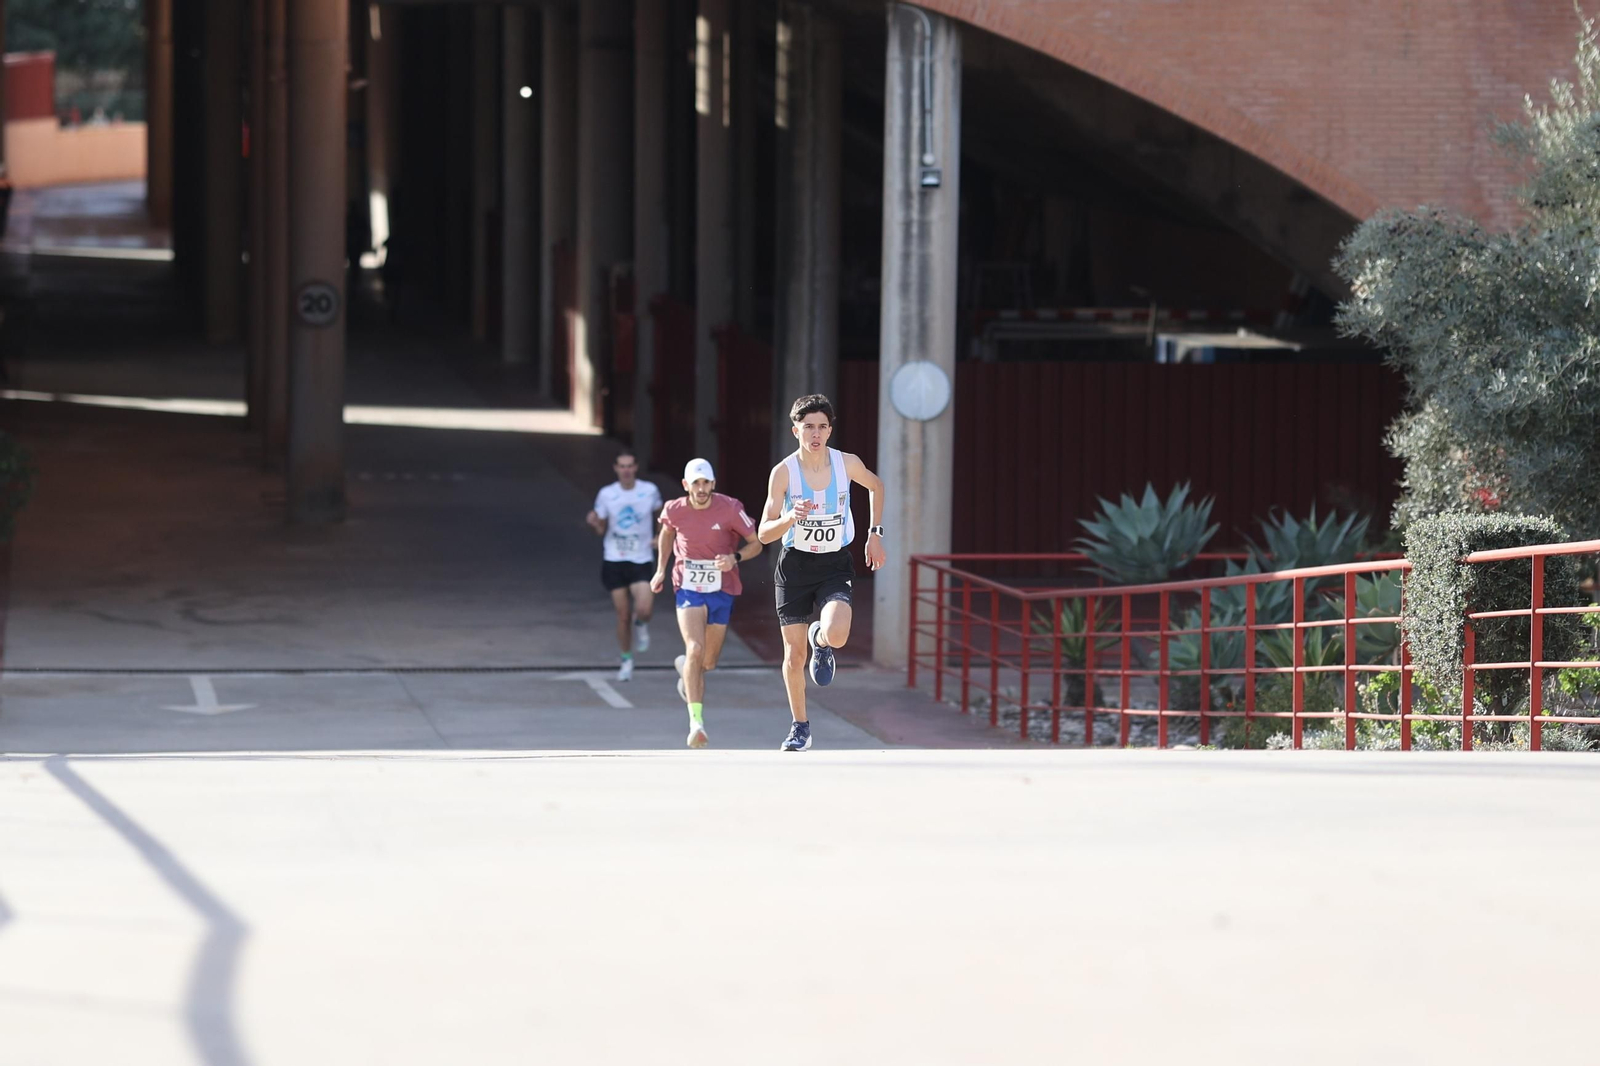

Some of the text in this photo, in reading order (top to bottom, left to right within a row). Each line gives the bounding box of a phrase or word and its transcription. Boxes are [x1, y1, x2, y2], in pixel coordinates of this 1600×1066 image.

[303, 293, 331, 313] 20
[803, 528, 835, 542] 700
[689, 571, 716, 583] 276
